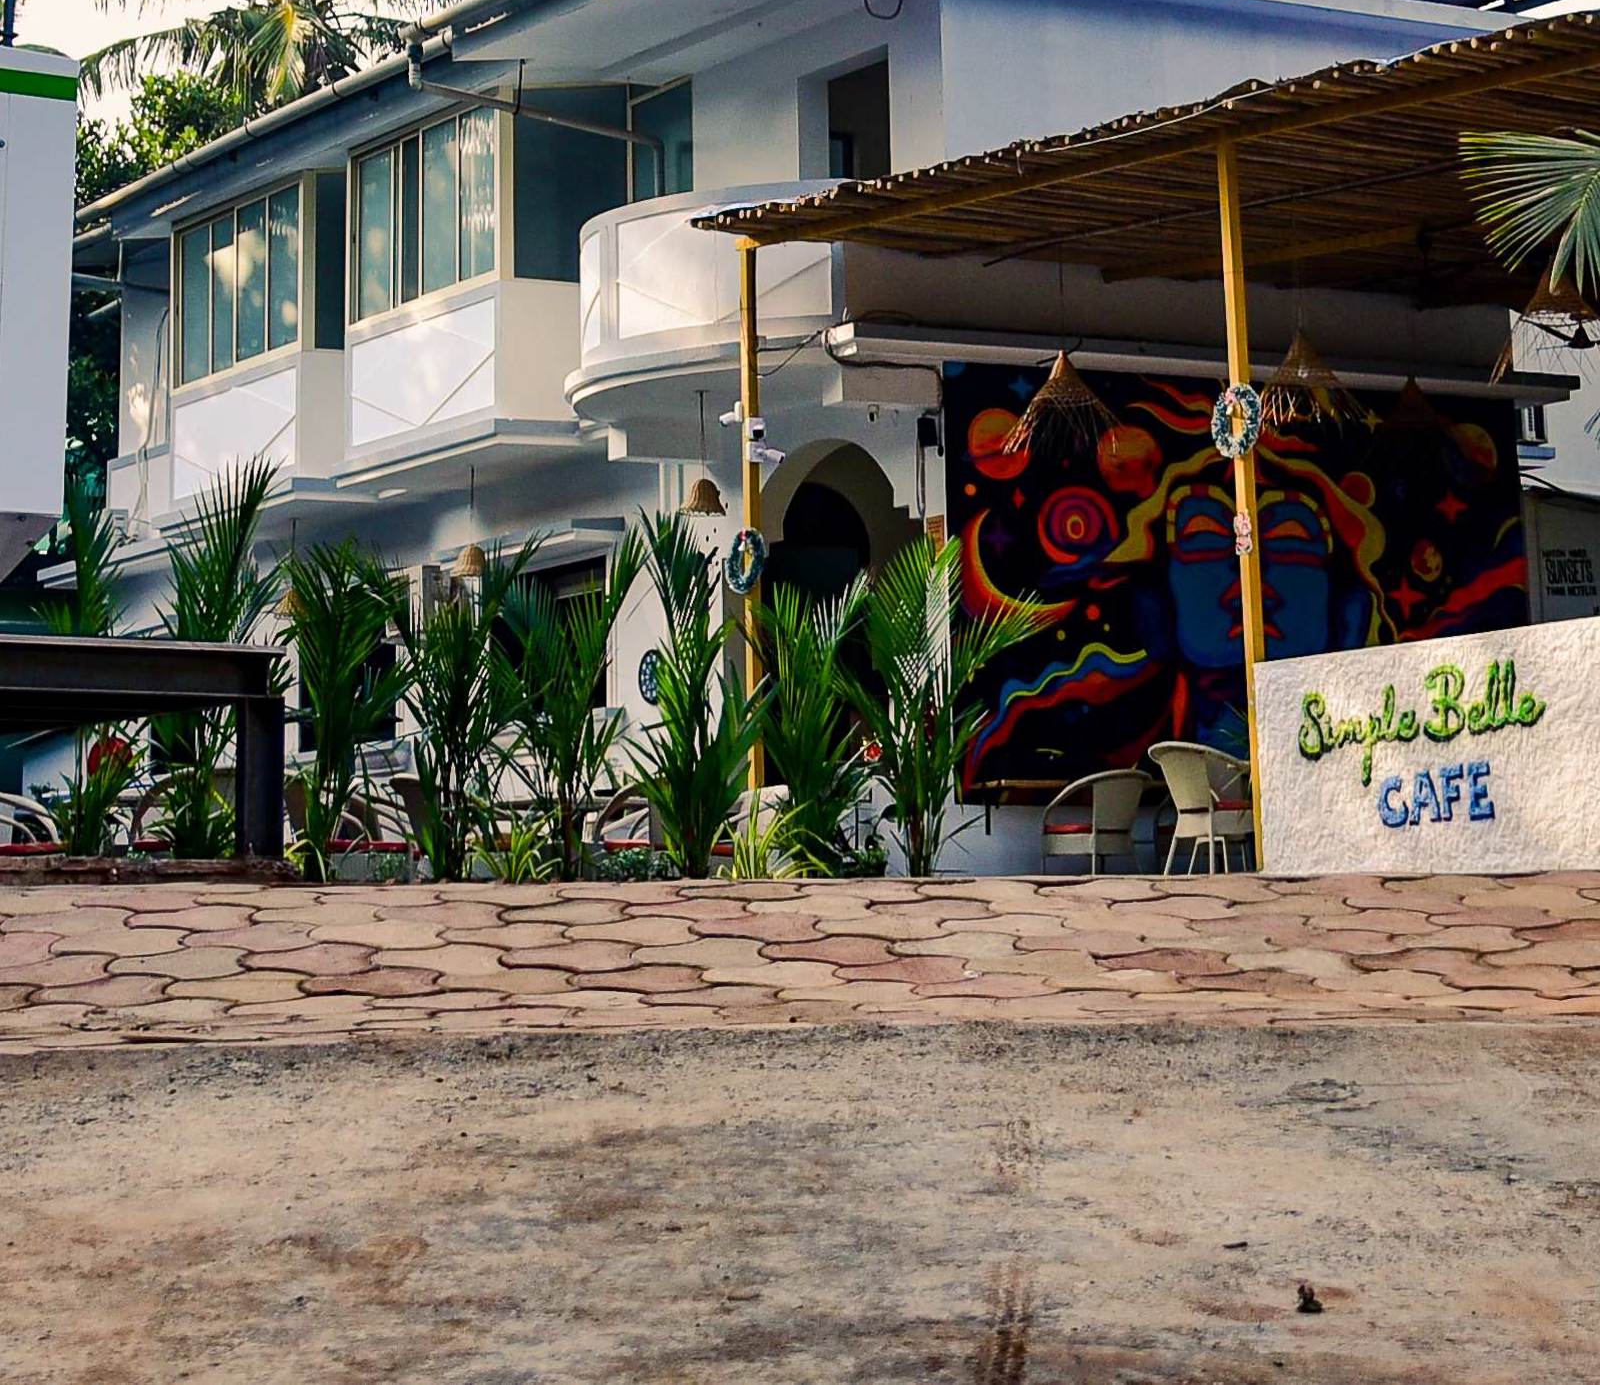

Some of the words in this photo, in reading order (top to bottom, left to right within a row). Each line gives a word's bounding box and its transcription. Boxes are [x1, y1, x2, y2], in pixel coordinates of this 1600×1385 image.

[1545, 557, 1593, 584] SUNSETS
[1299, 682, 1421, 787] Simple
[1422, 658, 1548, 743] Belle
[1378, 758, 1497, 829] CAFE
